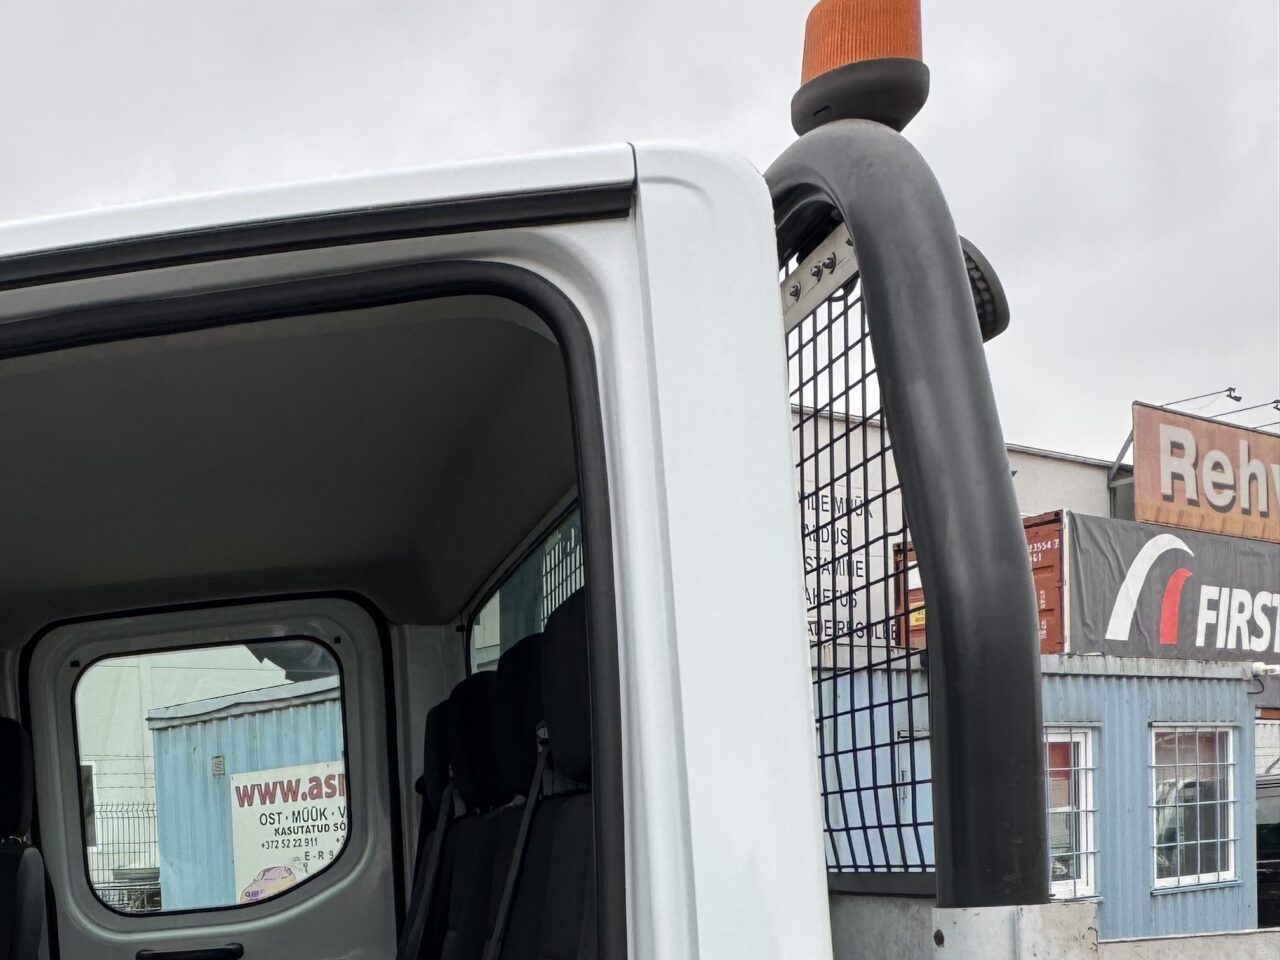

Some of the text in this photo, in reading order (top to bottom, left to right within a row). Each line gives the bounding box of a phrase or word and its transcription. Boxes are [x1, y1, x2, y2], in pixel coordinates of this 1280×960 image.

[274, 824, 330, 837] KASUTATUD
[261, 839, 279, 850] +372
[282, 838, 291, 849] 52
[293, 838, 303, 848] 22
[305, 837, 318, 847] 911
